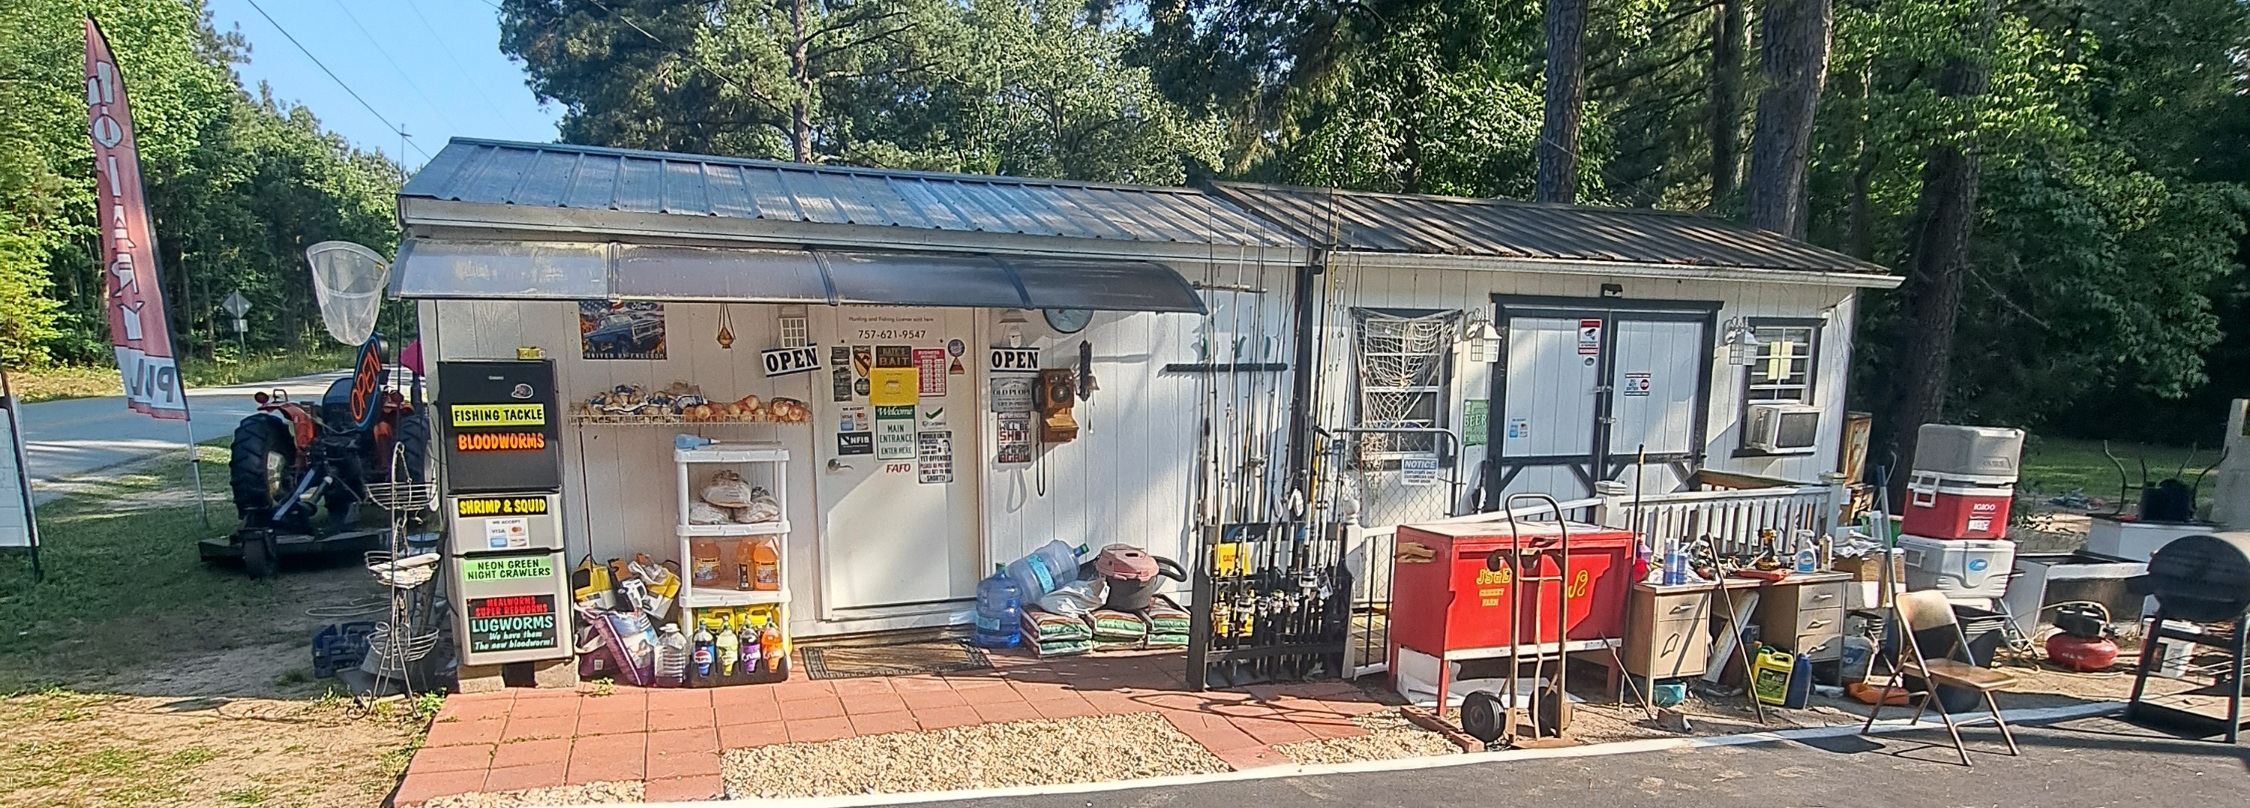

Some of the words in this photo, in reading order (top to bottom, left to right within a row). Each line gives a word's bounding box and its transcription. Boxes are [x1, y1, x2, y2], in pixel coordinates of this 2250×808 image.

[858, 330, 926, 339] 757-621-9547
[766, 347, 818, 373] OPEN
[880, 357, 908, 366] BAIT
[992, 351, 1038, 368] OPEN
[352, 343, 380, 420] OPEN
[455, 410, 500, 421] FISHING
[504, 409, 543, 420] TACKLE
[878, 407, 913, 415] Welcome
[1464, 415, 1486, 427] BEER
[887, 425, 904, 433] MAIN
[458, 433, 545, 450] BLOODWORMS
[880, 434, 912, 443] ENTRANCE
[1000, 431, 1029, 441] SHOT
[886, 464, 911, 473] FAFO
[460, 500, 501, 514] SHRIMP
[504, 501, 512, 513] &
[514, 499, 546, 512] SQUID
[478, 561, 504, 570] NEON
[508, 559, 539, 568] GREEN
[468, 571, 496, 580] NIGHT
[500, 568, 550, 578] CRAWLERS
[487, 597, 535, 606] MEALWORMS
[475, 606, 501, 617] SUPER
[504, 603, 547, 615] REDWORMS
[472, 616, 553, 632] LUGWORMS
[489, 632, 501, 640] We
[503, 631, 520, 639] have
[524, 630, 542, 638] them
[475, 641, 489, 650] The
[509, 637, 554, 648] bloodworm!
